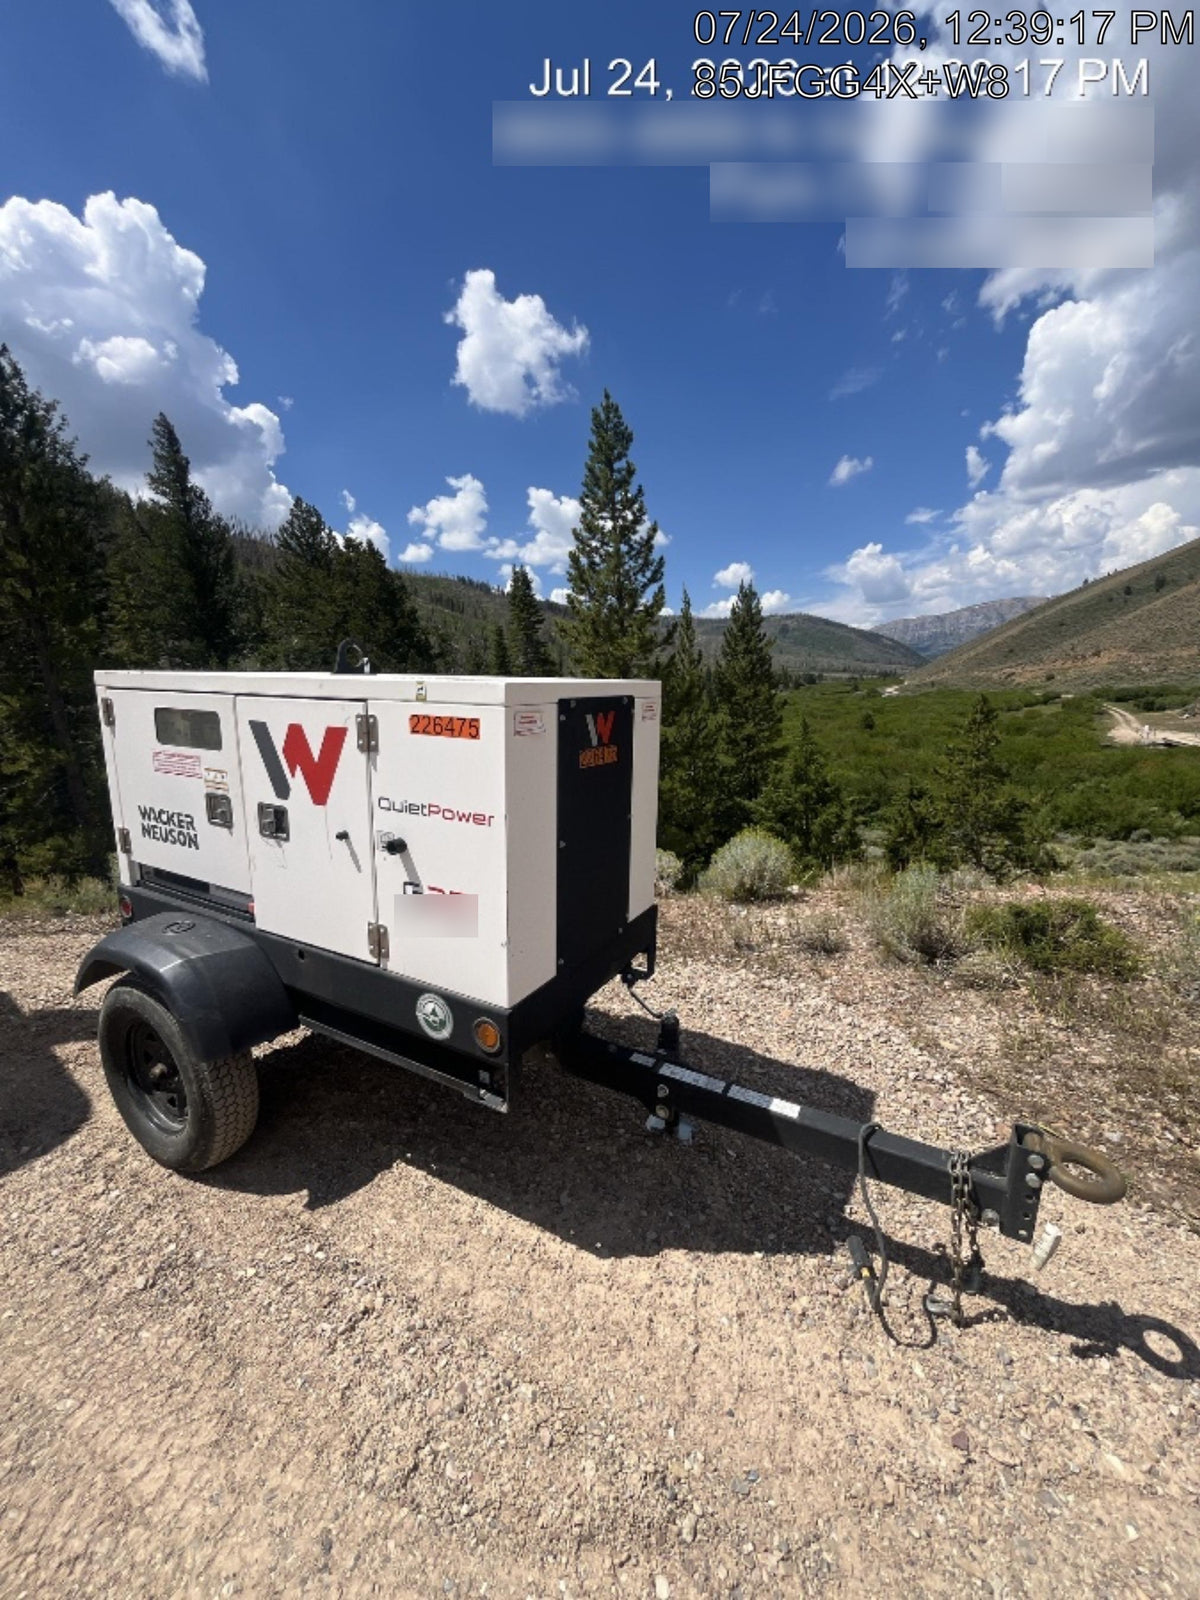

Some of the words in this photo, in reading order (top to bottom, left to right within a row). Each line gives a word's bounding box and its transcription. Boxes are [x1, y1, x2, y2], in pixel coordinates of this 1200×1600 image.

[410, 714, 480, 739] 226475
[138, 805, 197, 832] WACKER
[378, 796, 495, 827] QuietPower
[141, 823, 200, 850] NEUSON
